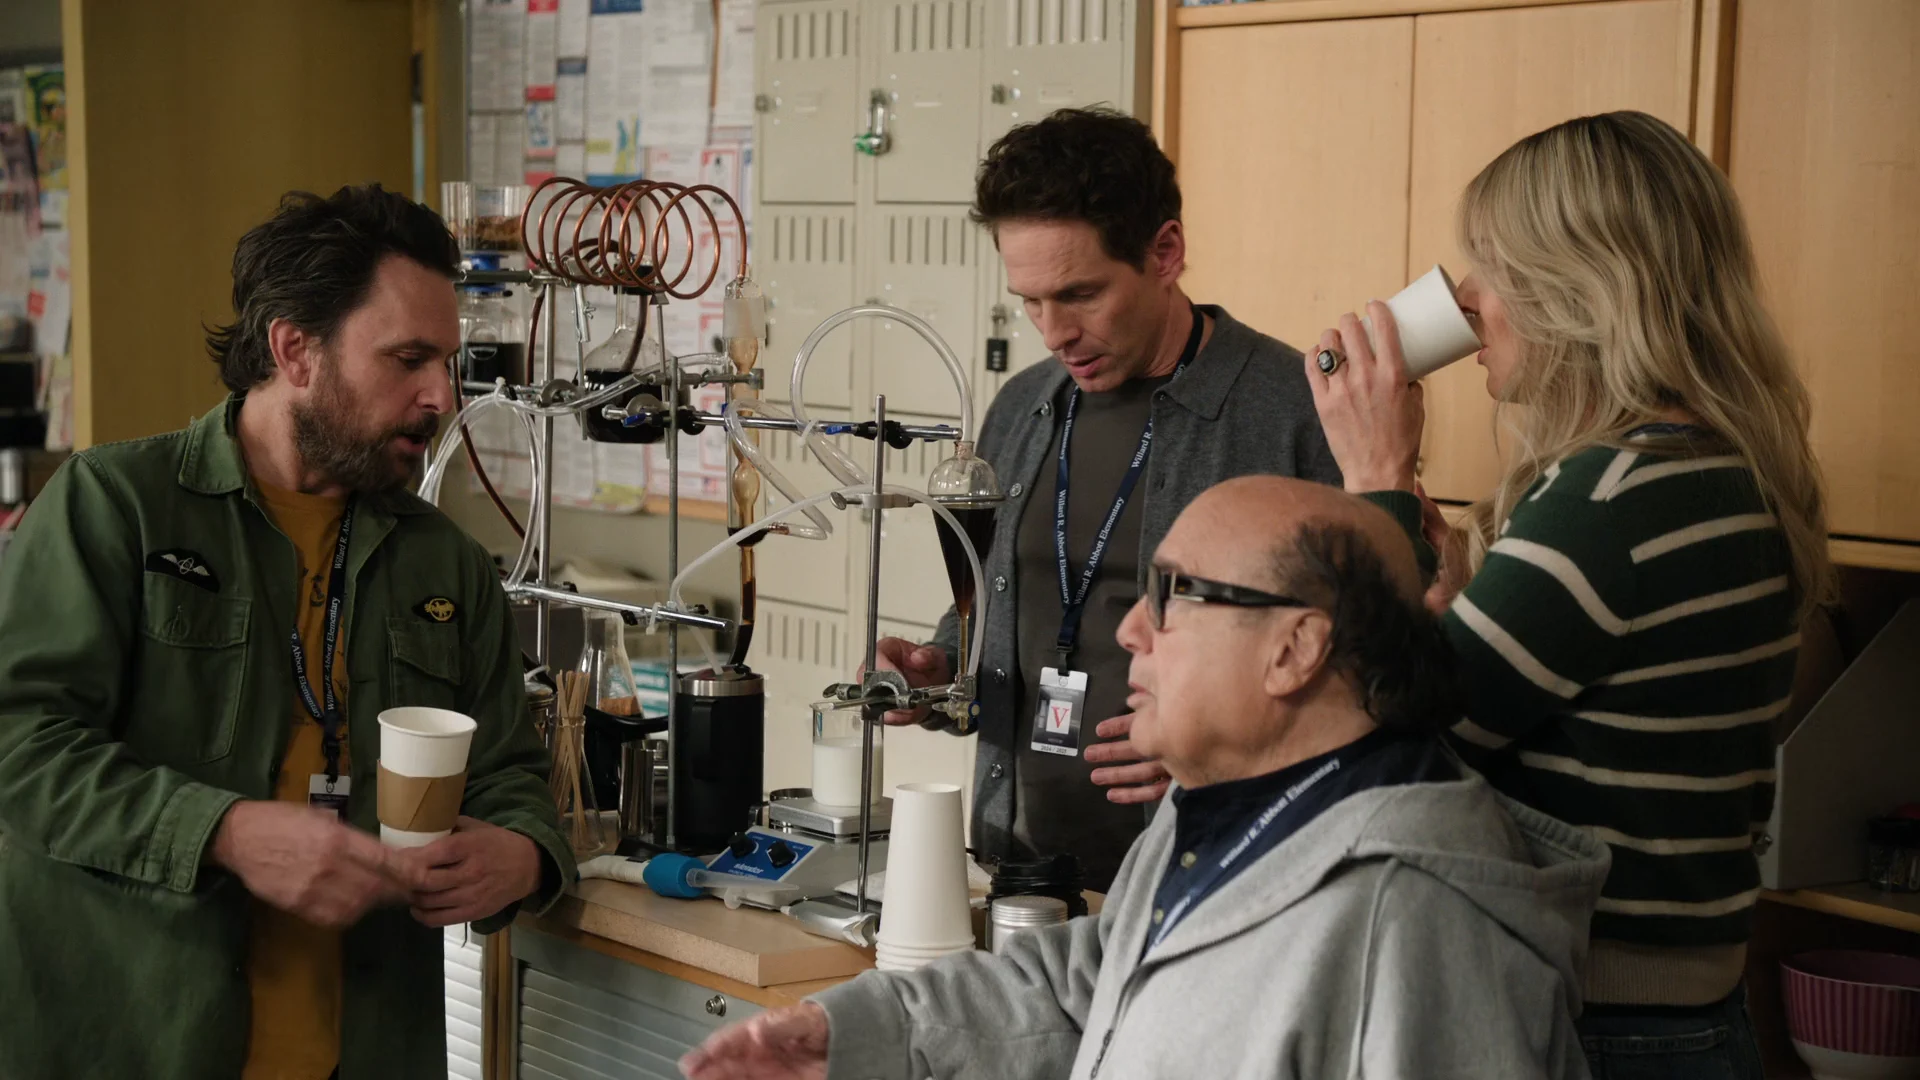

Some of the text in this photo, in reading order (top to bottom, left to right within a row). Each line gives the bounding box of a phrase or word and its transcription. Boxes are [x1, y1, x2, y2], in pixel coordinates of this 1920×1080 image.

[1131, 440, 1149, 468] Willard
[1057, 489, 1067, 518] Willard
[1099, 496, 1125, 540] Elementary
[334, 544, 346, 569] Willard
[1056, 530, 1067, 558] Abbott
[1088, 541, 1105, 567] Abbott
[1059, 557, 1070, 605] Elementary
[1084, 568, 1094, 579] R.
[326, 597, 341, 642] Elementary
[325, 643, 333, 671] Abbott
[291, 645, 322, 719] Abbott Elementary
[1051, 706, 1069, 728] V
